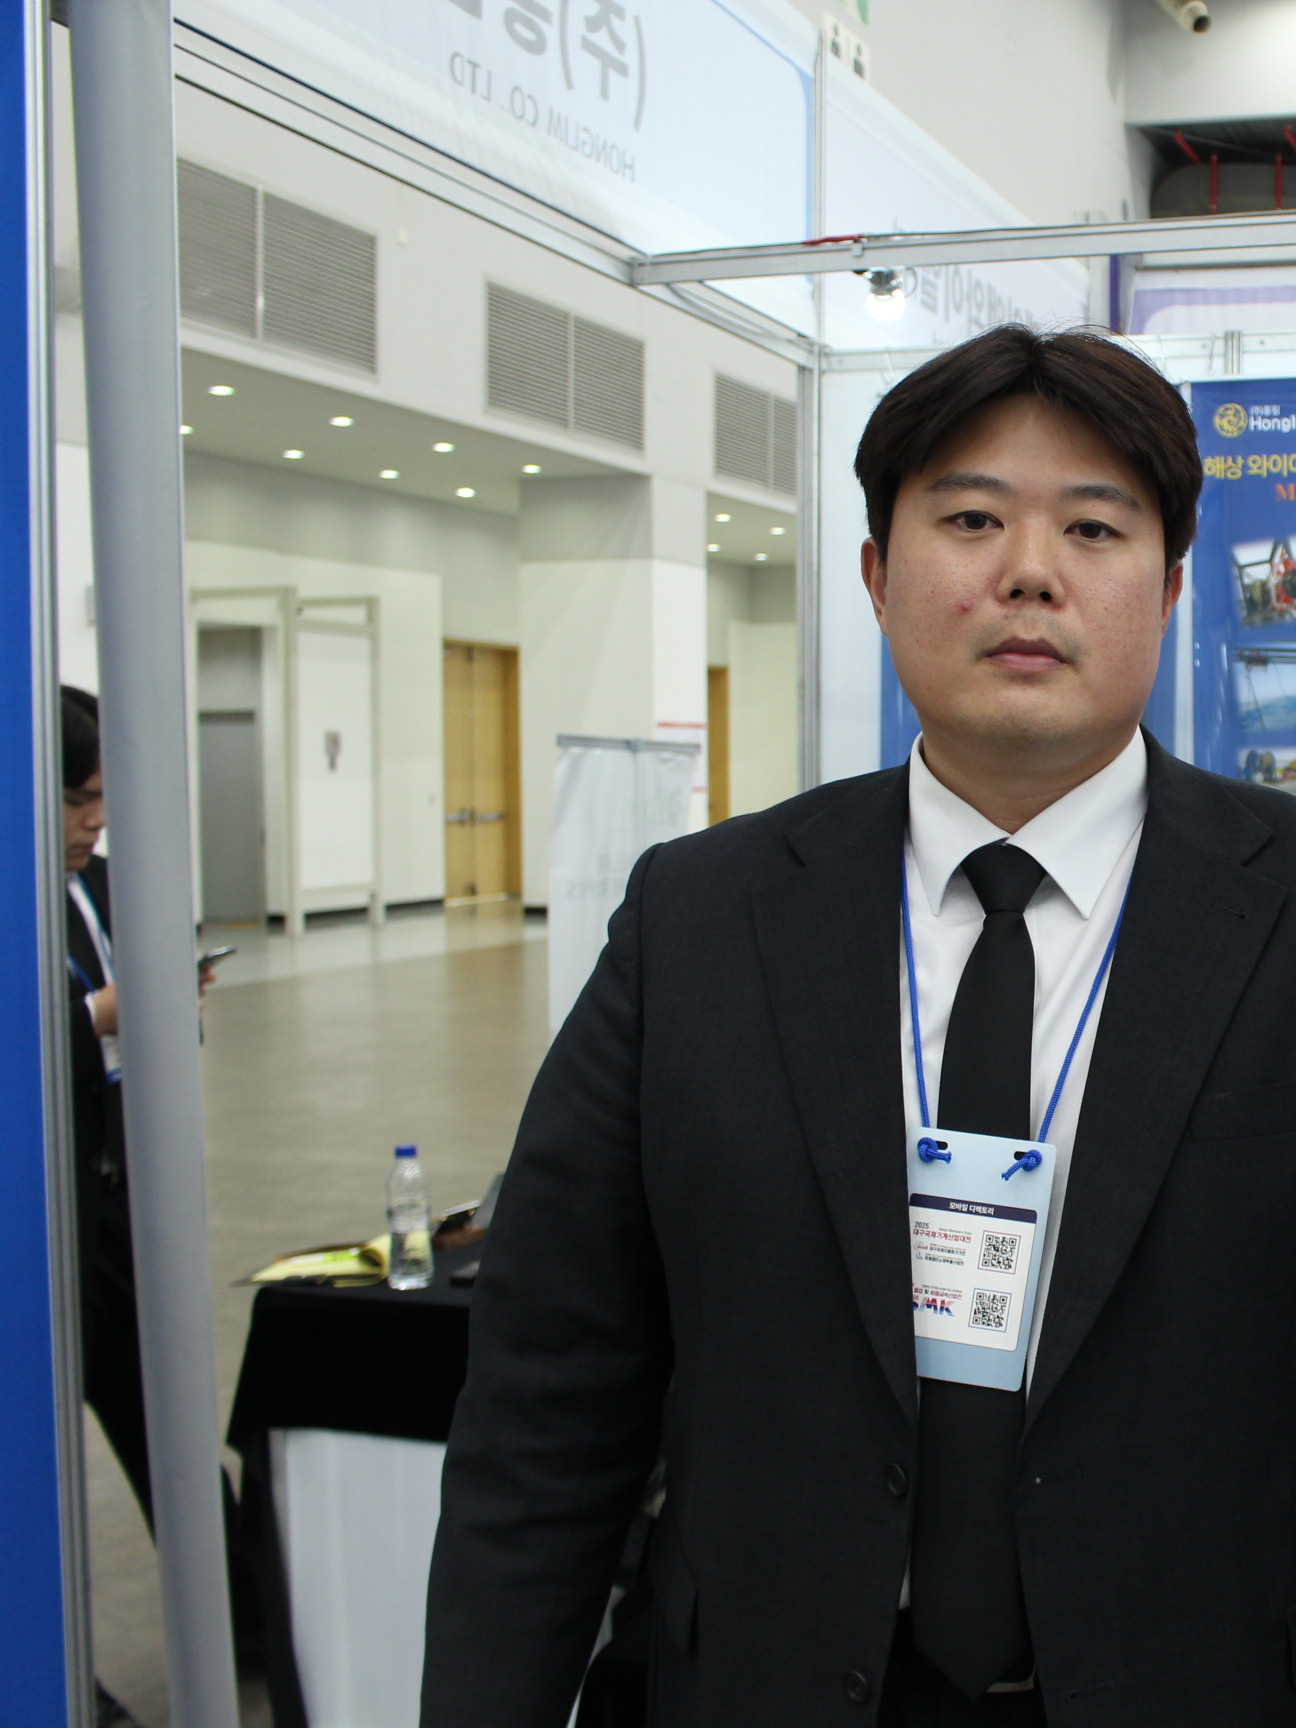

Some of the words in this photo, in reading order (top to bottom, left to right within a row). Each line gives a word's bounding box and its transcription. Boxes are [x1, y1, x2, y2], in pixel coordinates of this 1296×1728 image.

[1204, 456, 1243, 480] 해상
[949, 1201, 968, 1214] 모바일
[969, 1203, 994, 1216] 디렉토리
[914, 1221, 929, 1230] 2025
